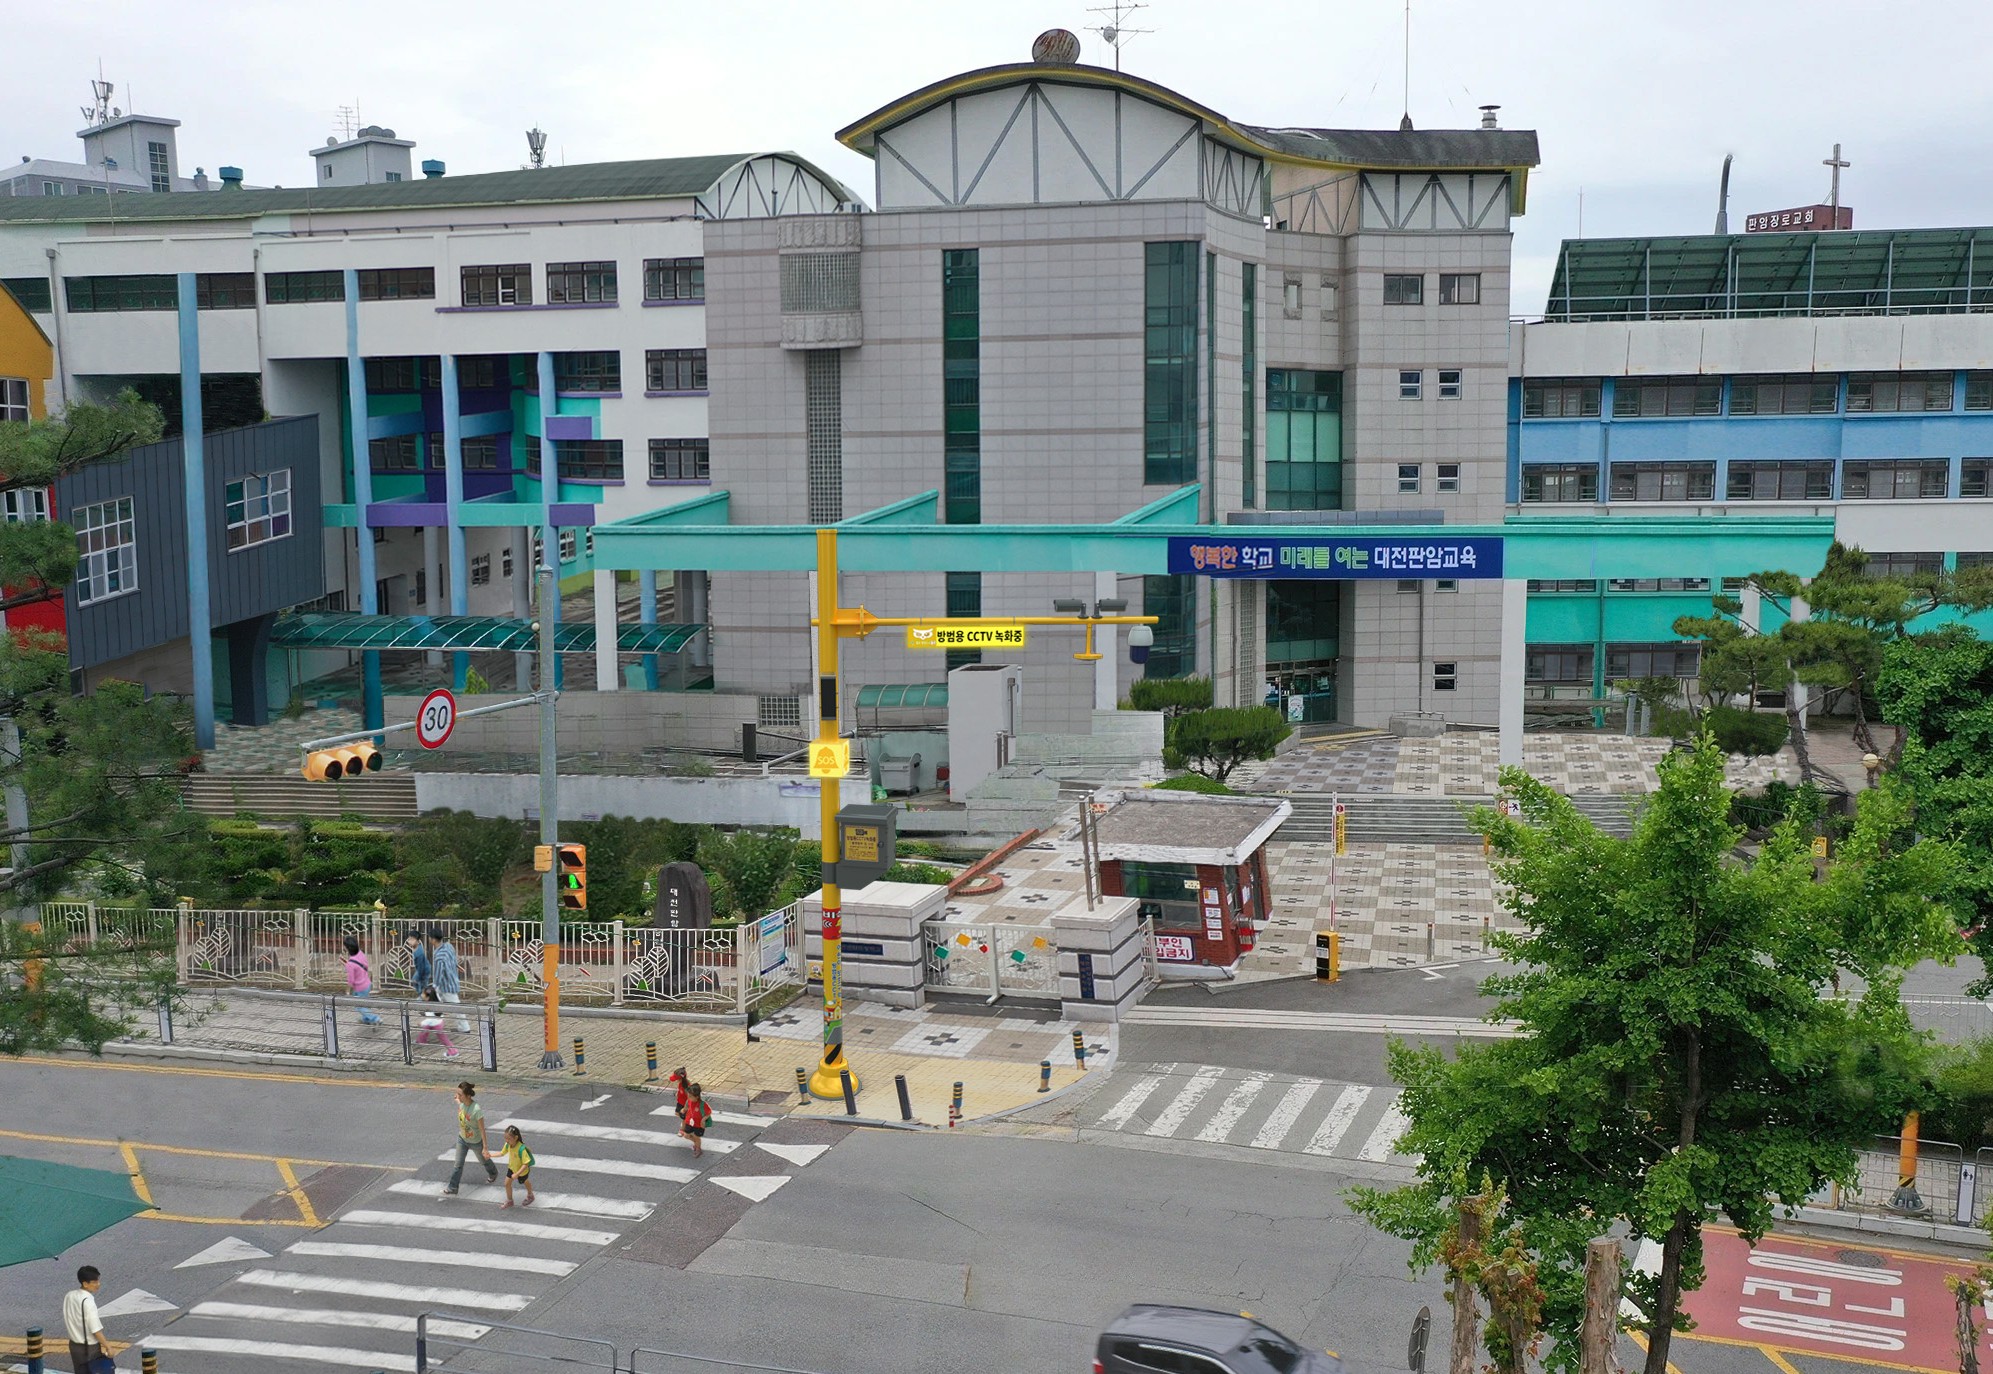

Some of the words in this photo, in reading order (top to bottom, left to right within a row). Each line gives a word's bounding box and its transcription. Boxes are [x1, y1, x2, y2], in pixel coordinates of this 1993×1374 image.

[1748, 209, 1814, 231] 판암장로교회
[1189, 544, 1238, 570] 행복한
[1242, 545, 1274, 570] 학교
[1280, 546, 1330, 570] 미래를
[1334, 546, 1369, 570] 여는
[1374, 545, 1476, 569] 대전판암교육
[937, 630, 964, 643] 방범용
[967, 631, 993, 642] CCTV
[995, 630, 1022, 643] 녹화중
[425, 705, 448, 732] 30
[817, 756, 835, 765] SOS
[1156, 947, 1190, 959] 입금지
